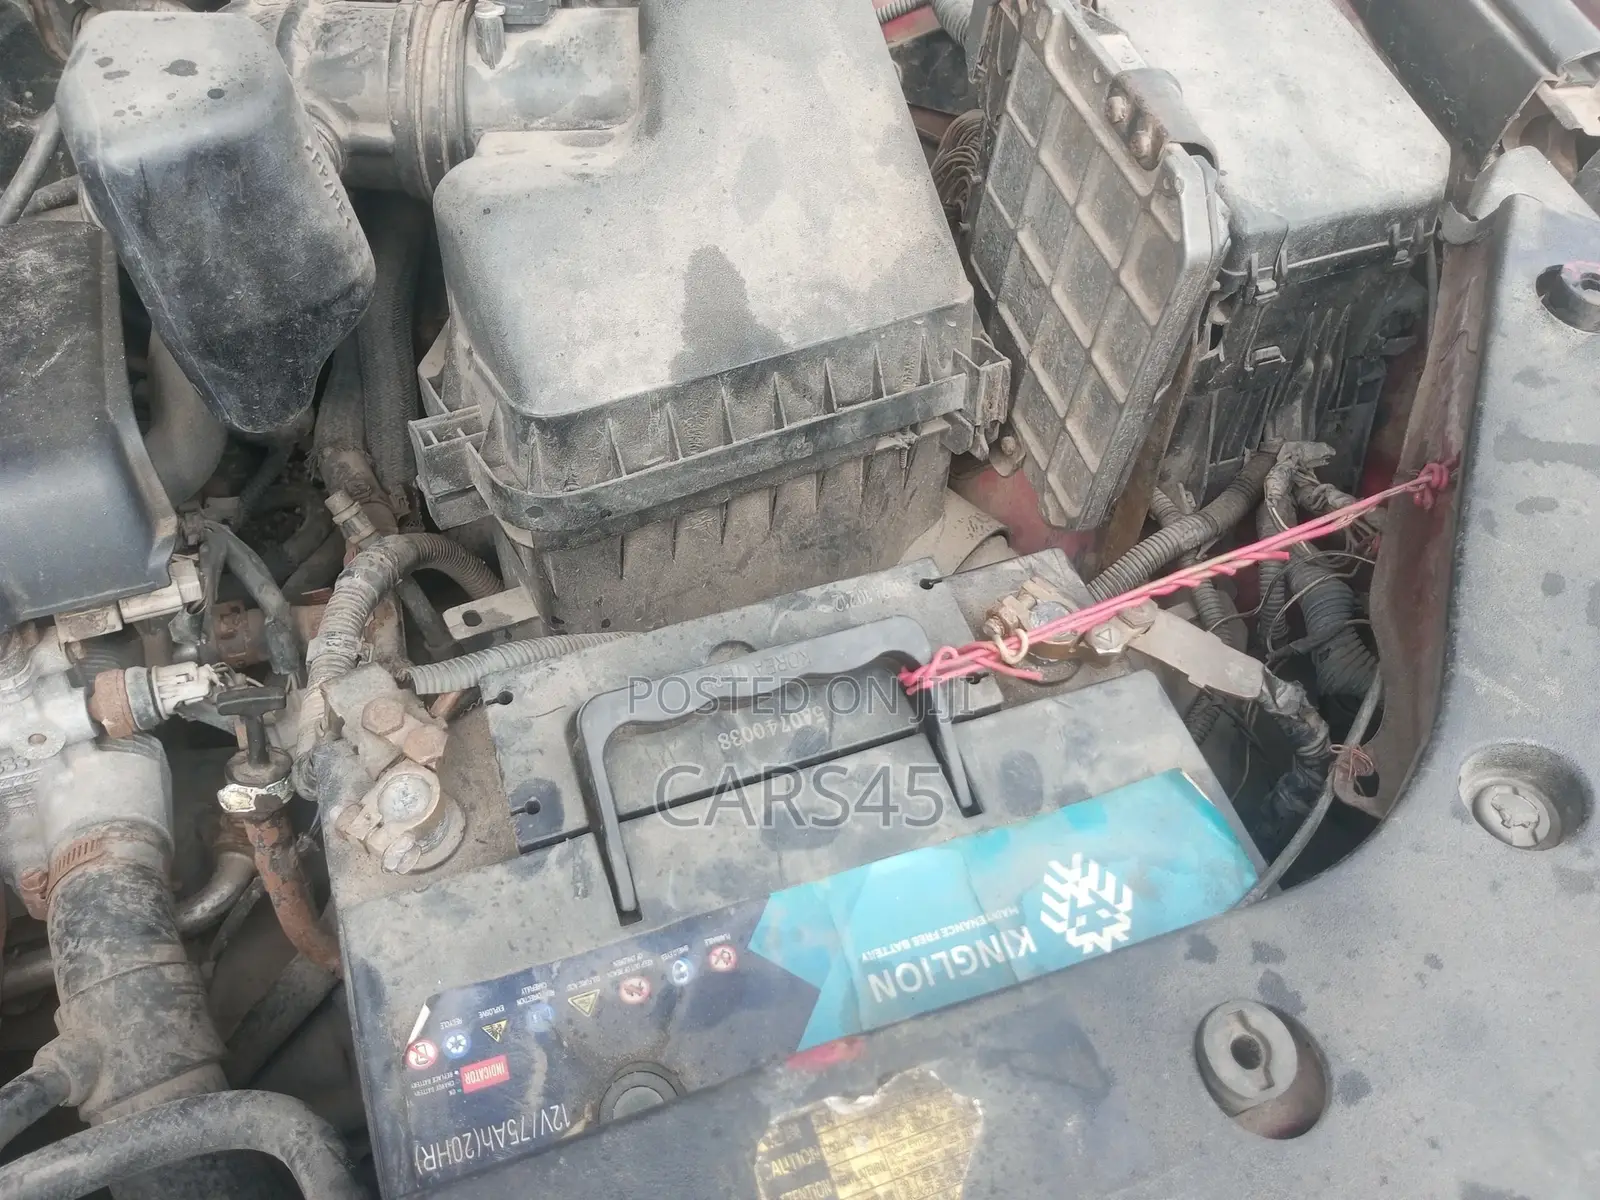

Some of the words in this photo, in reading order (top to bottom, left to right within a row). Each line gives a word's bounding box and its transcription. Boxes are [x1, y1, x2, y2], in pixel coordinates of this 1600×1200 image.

[861, 939, 911, 962] BATTERY
[911, 930, 942, 947] FREE
[868, 925, 1037, 1003] KINGLION
[464, 1061, 505, 1085] INDICATOR
[414, 1103, 571, 1176] 12V/75Ah(20HR)
